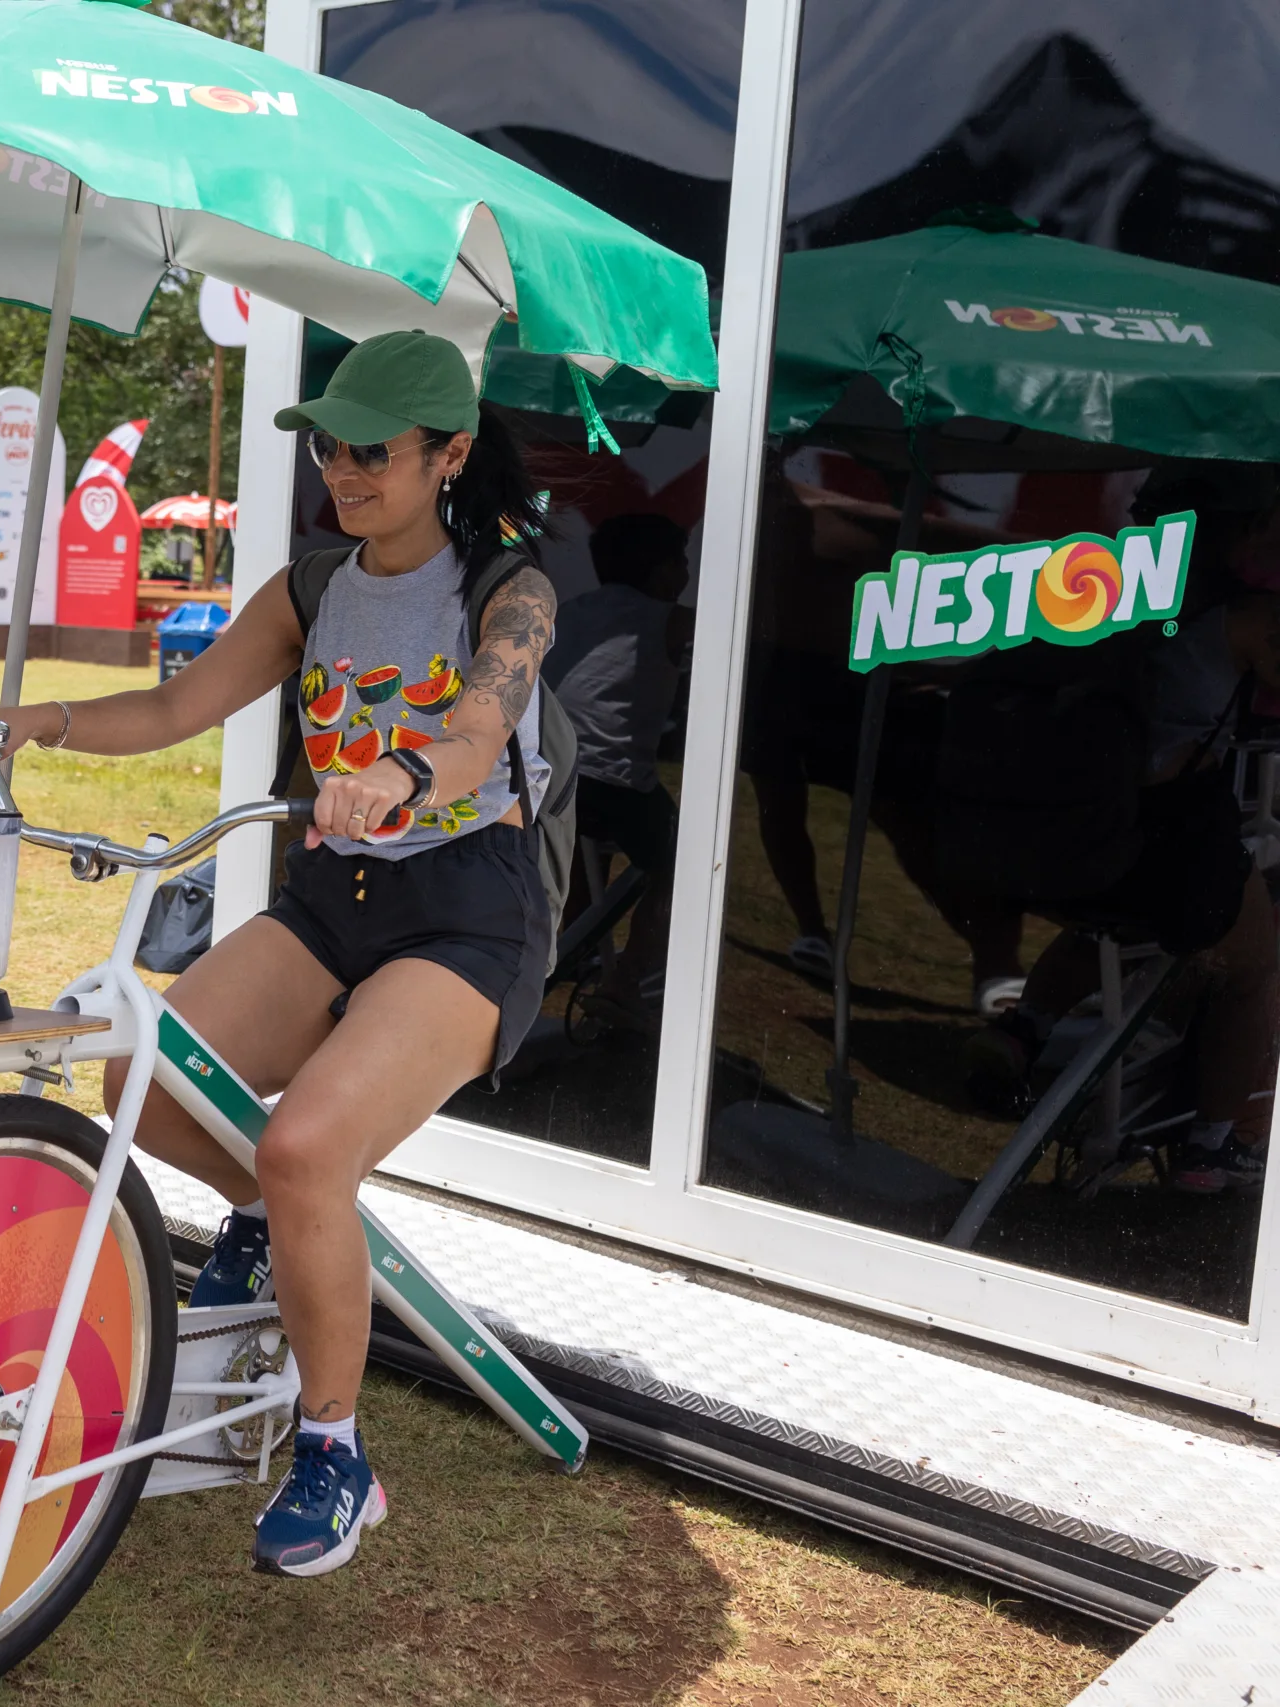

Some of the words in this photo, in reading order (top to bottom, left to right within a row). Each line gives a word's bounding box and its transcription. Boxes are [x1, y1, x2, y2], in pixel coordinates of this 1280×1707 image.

[41, 69, 298, 116] NESTON
[853, 521, 1188, 661] NESTON
[184, 1054, 215, 1078] NESTON
[380, 1255, 406, 1275] NESTON
[332, 1487, 355, 1543] FILA
